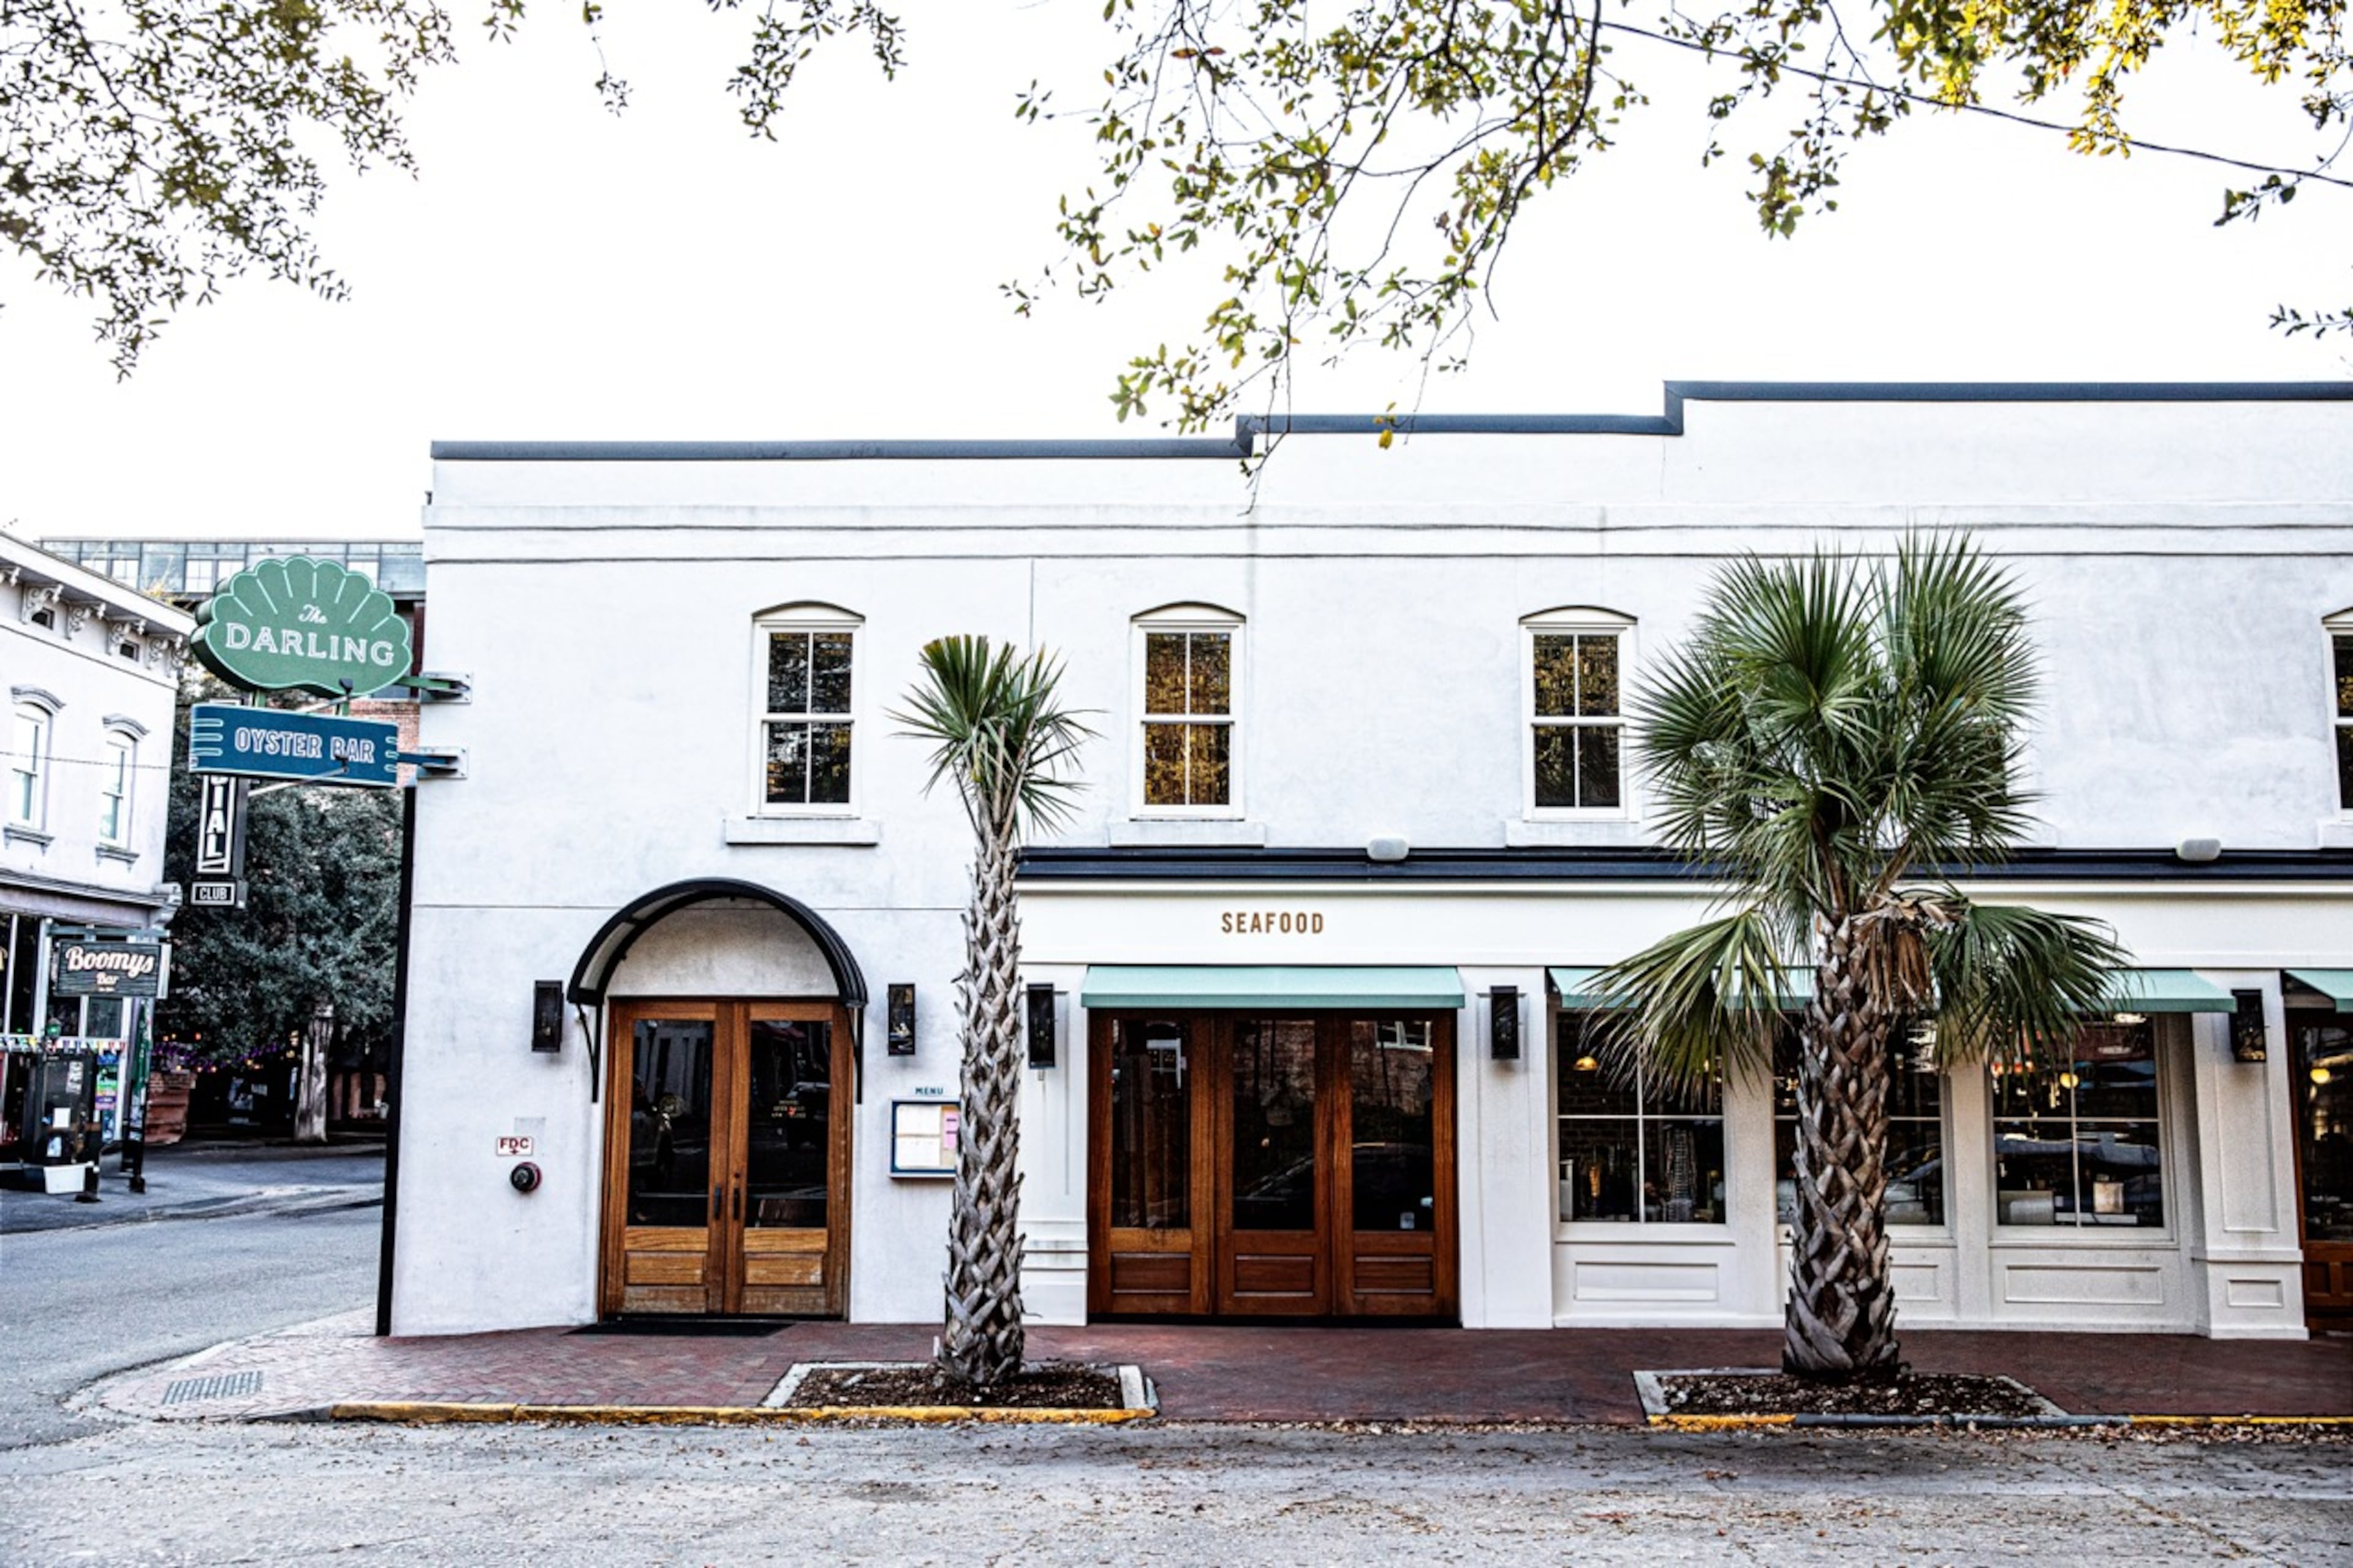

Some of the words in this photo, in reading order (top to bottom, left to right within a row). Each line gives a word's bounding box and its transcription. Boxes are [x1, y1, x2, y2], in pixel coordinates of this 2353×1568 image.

[298, 604, 328, 624] The
[225, 622, 395, 667] DARLING
[234, 727, 323, 759] OYSTER
[330, 736, 375, 764] BAR
[199, 887, 227, 900] CLUB
[1221, 911, 1324, 934] SEAFOOD
[65, 945, 155, 979] Boomys
[96, 971, 119, 985] Bar
[915, 1087, 944, 1096] MENU
[499, 1137, 529, 1149] FDC
